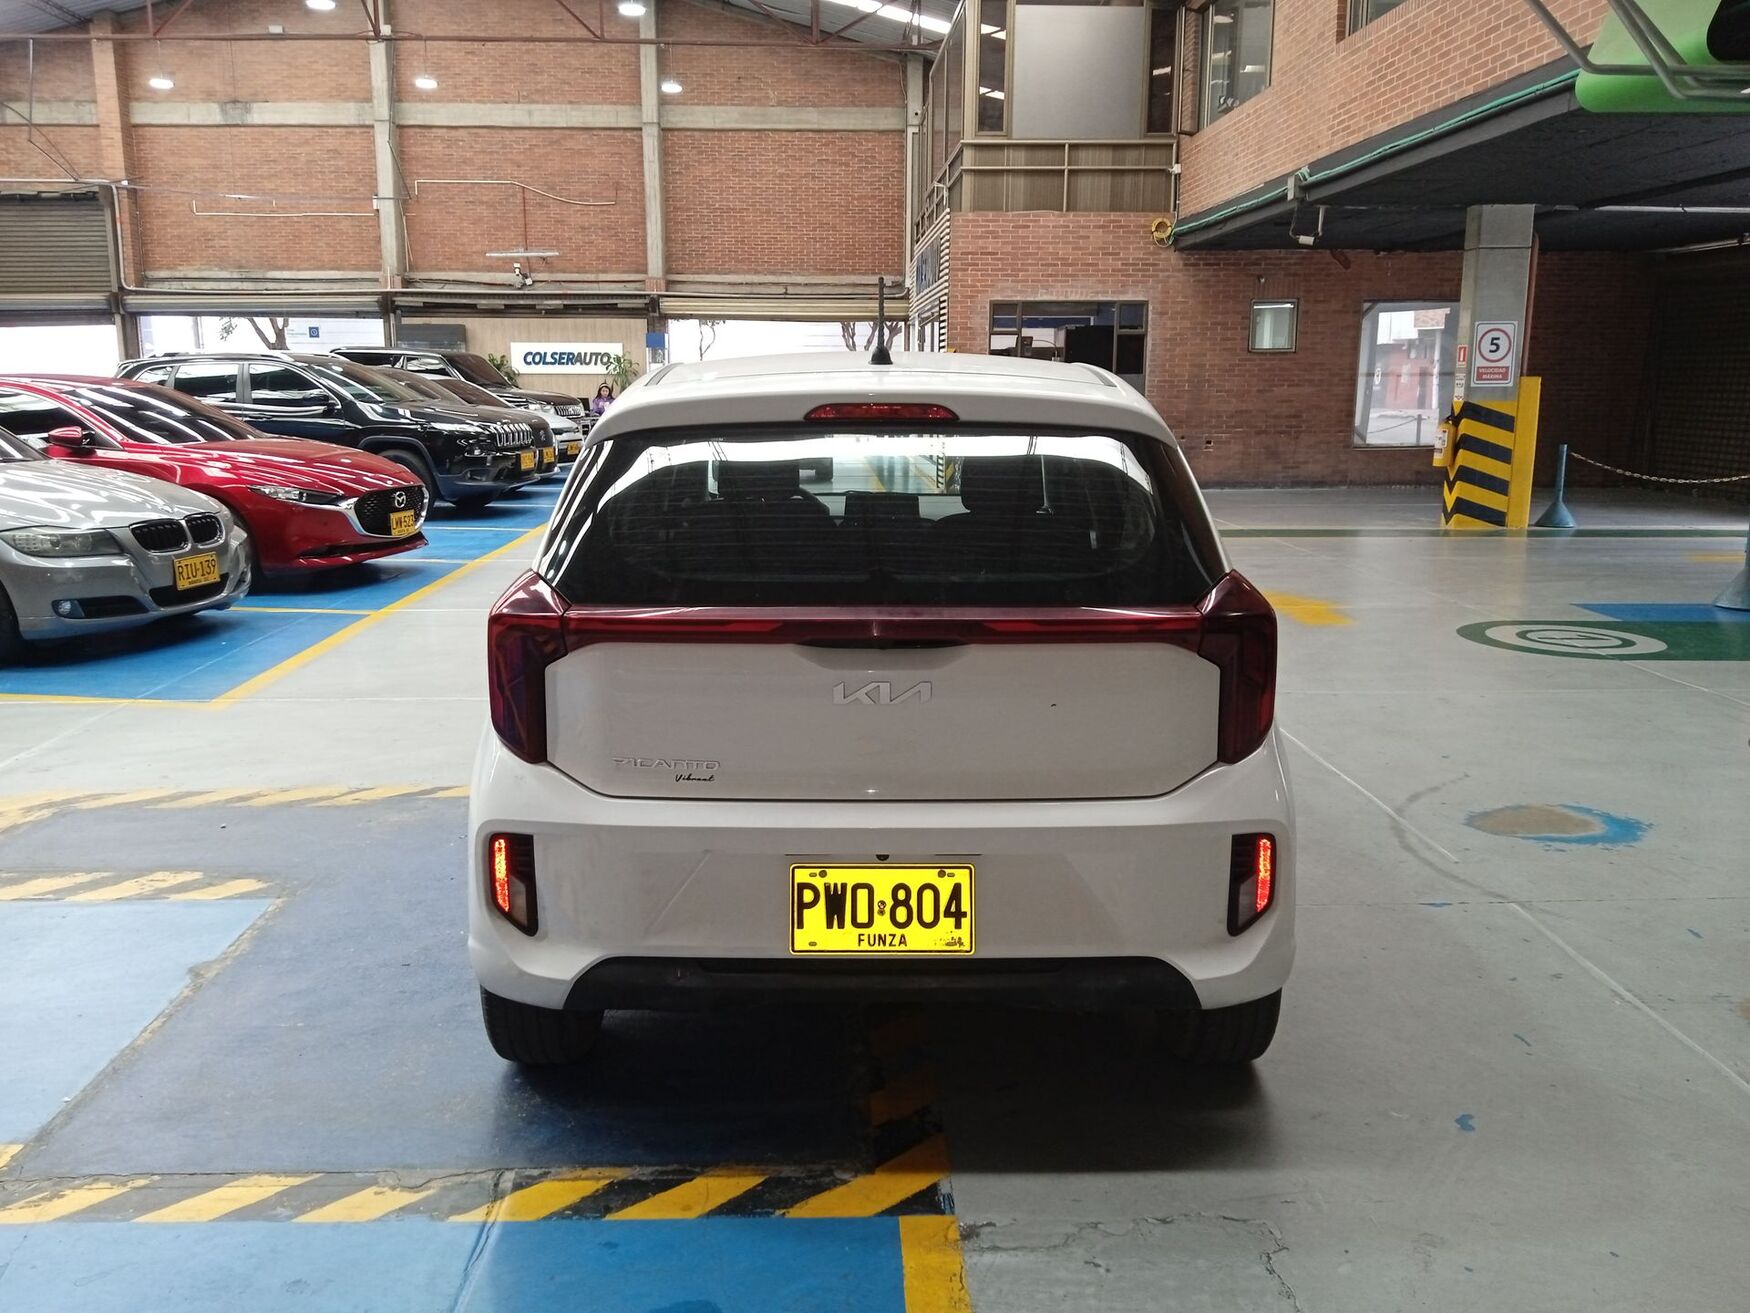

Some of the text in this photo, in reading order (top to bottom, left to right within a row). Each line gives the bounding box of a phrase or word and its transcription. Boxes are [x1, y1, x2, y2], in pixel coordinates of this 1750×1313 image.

[1489, 337, 1500, 353] 5
[523, 351, 612, 366] COLSERAUTO
[832, 680, 932, 704] KIA
[613, 757, 720, 770] PICANTO
[675, 773, 715, 782] Vibrant
[858, 933, 907, 947] FUNZA
